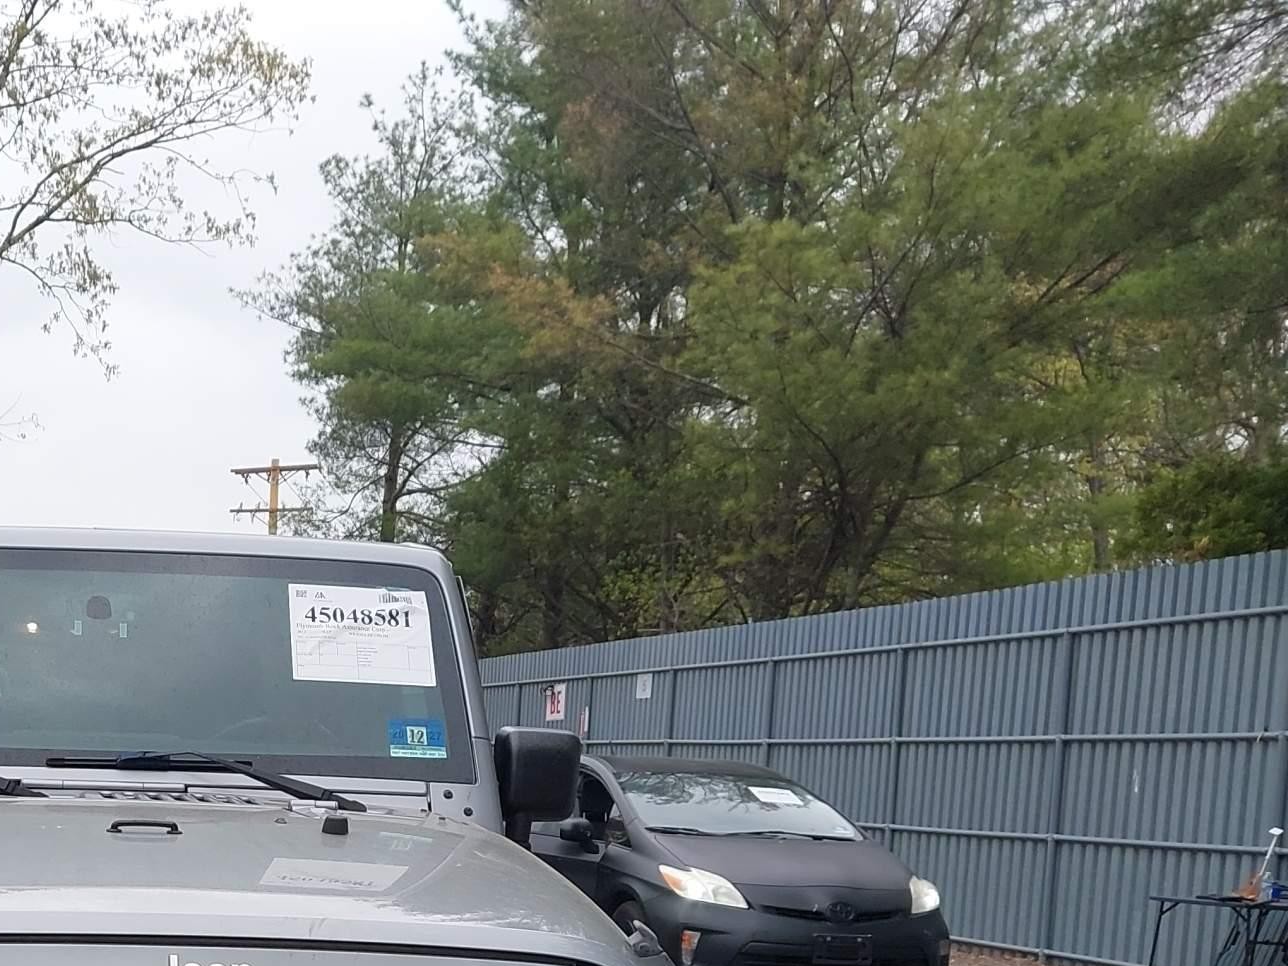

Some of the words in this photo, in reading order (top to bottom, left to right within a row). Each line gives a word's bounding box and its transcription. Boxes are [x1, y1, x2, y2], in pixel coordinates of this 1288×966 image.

[304, 605, 411, 628] 45048581
[550, 690, 562, 715] BE
[408, 728, 425, 744] 12
